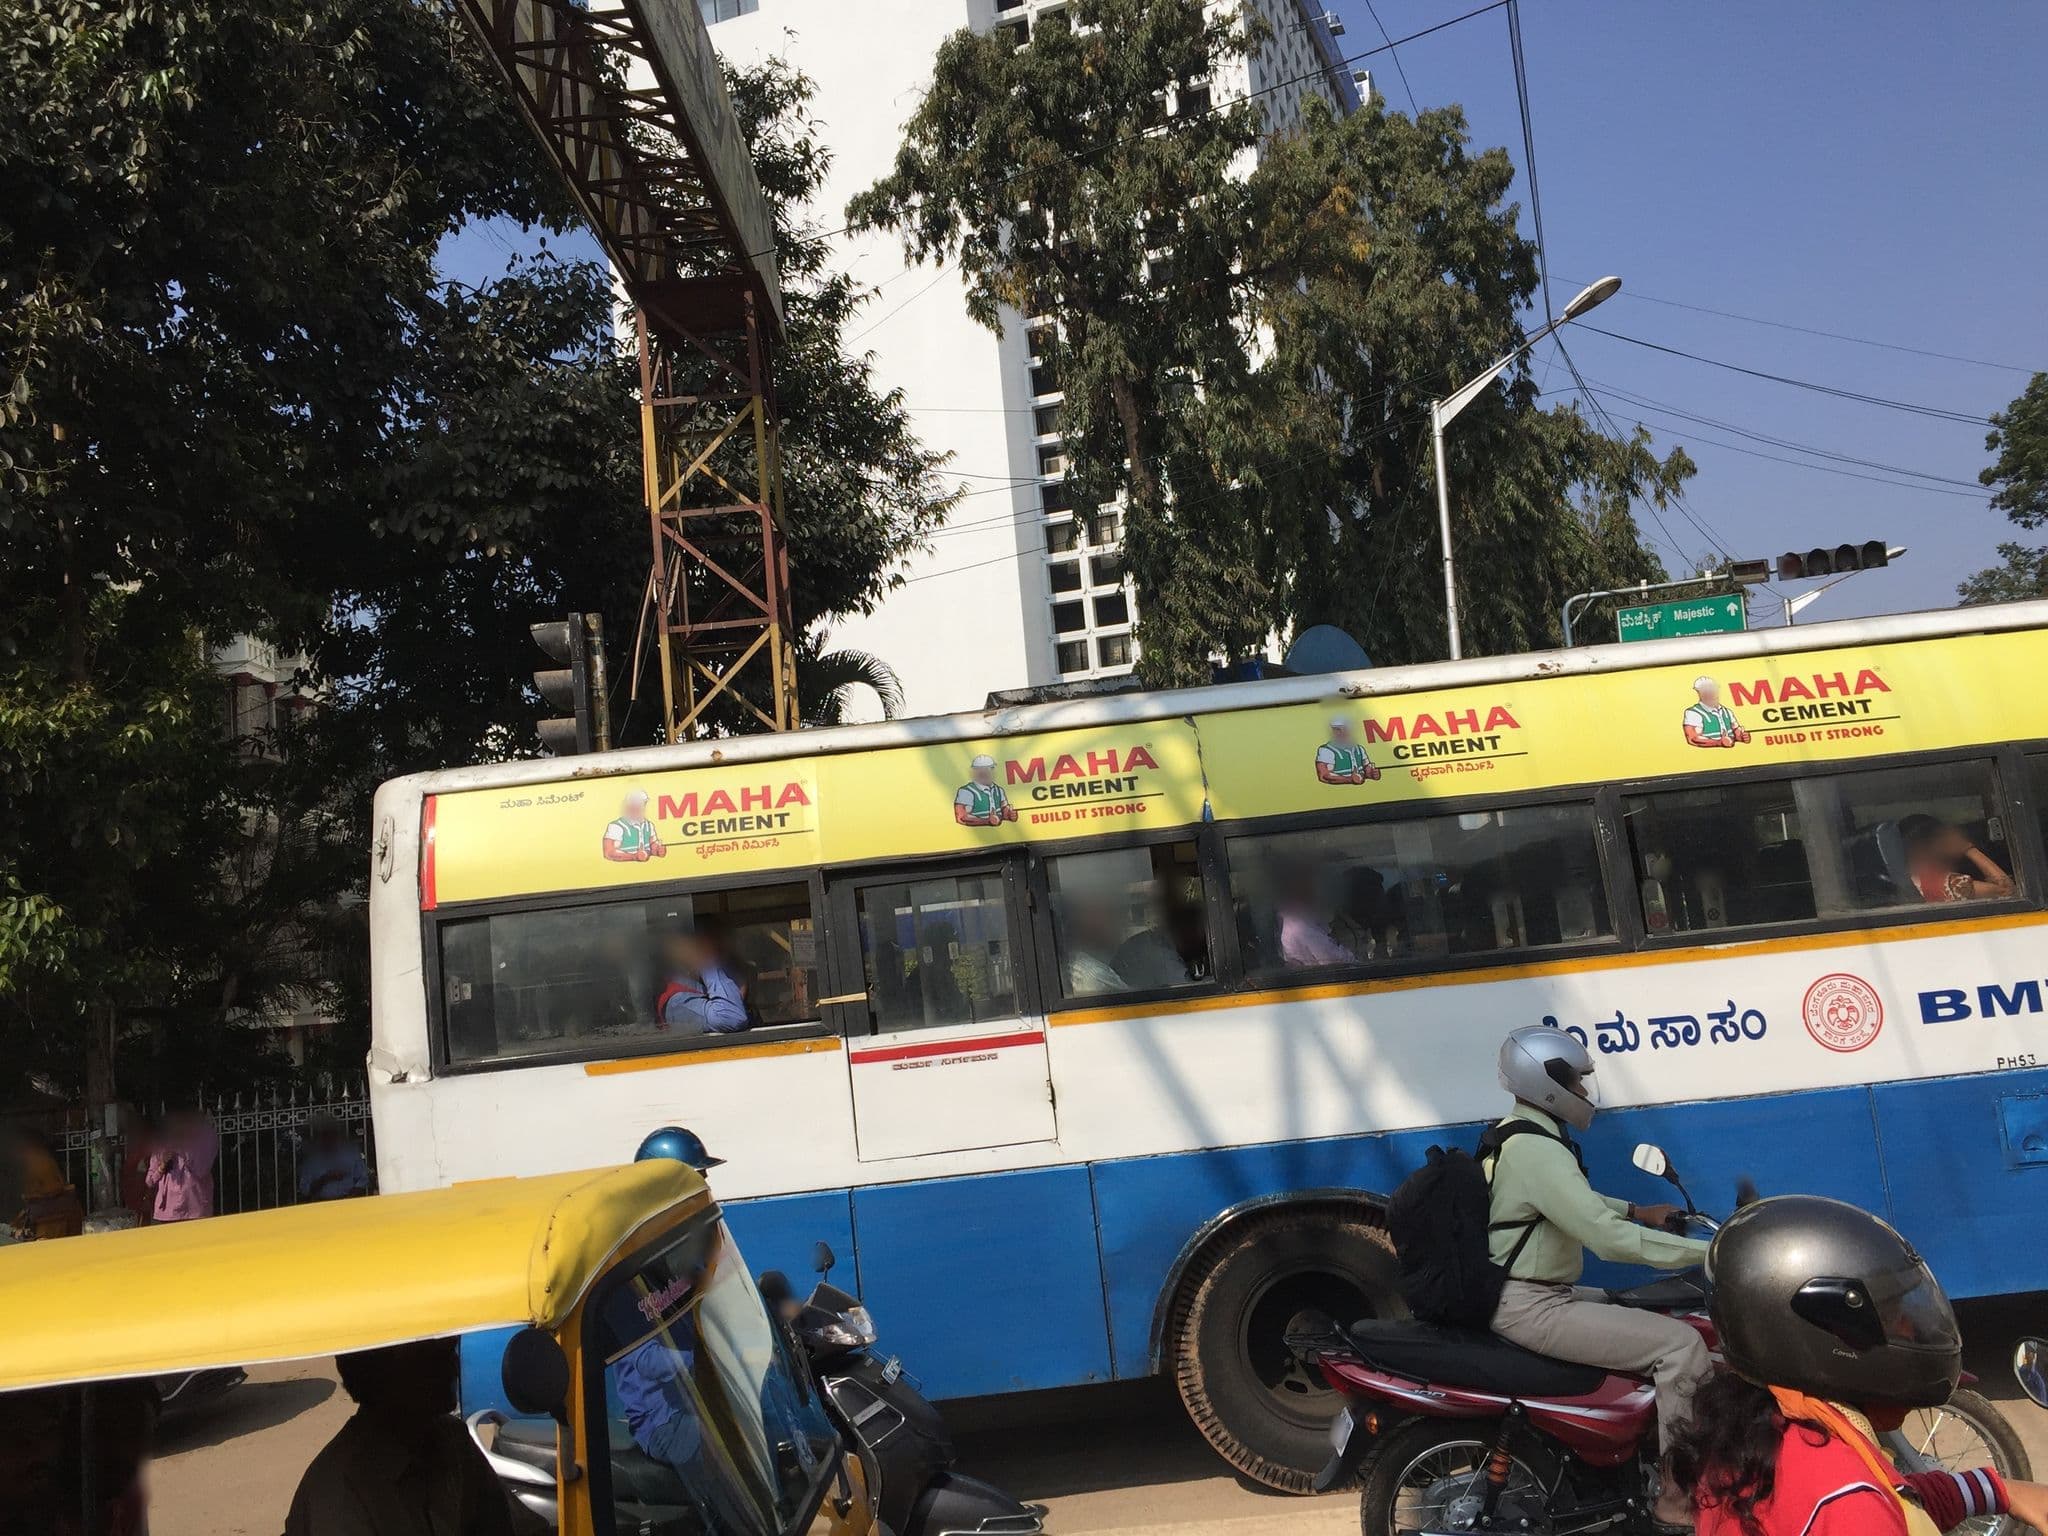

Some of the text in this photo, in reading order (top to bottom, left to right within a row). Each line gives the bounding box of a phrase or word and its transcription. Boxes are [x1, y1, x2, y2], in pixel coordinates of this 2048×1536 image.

[1674, 606, 1715, 621] Majestic
[1728, 669, 1892, 707] MAHA
[1762, 699, 1872, 723] CEMENT
[1363, 705, 1521, 744] MAHA
[1765, 725, 1884, 746] BUILD IT STRONG
[1393, 735, 1501, 760] CEMENT
[1005, 745, 1159, 785] MAHA
[658, 782, 811, 820] MAHA
[1032, 776, 1138, 801] CEMENT
[682, 812, 790, 837] CEMENT
[1031, 802, 1147, 824] BUILD IT STRONG
[1918, 978, 2048, 1024] BM
